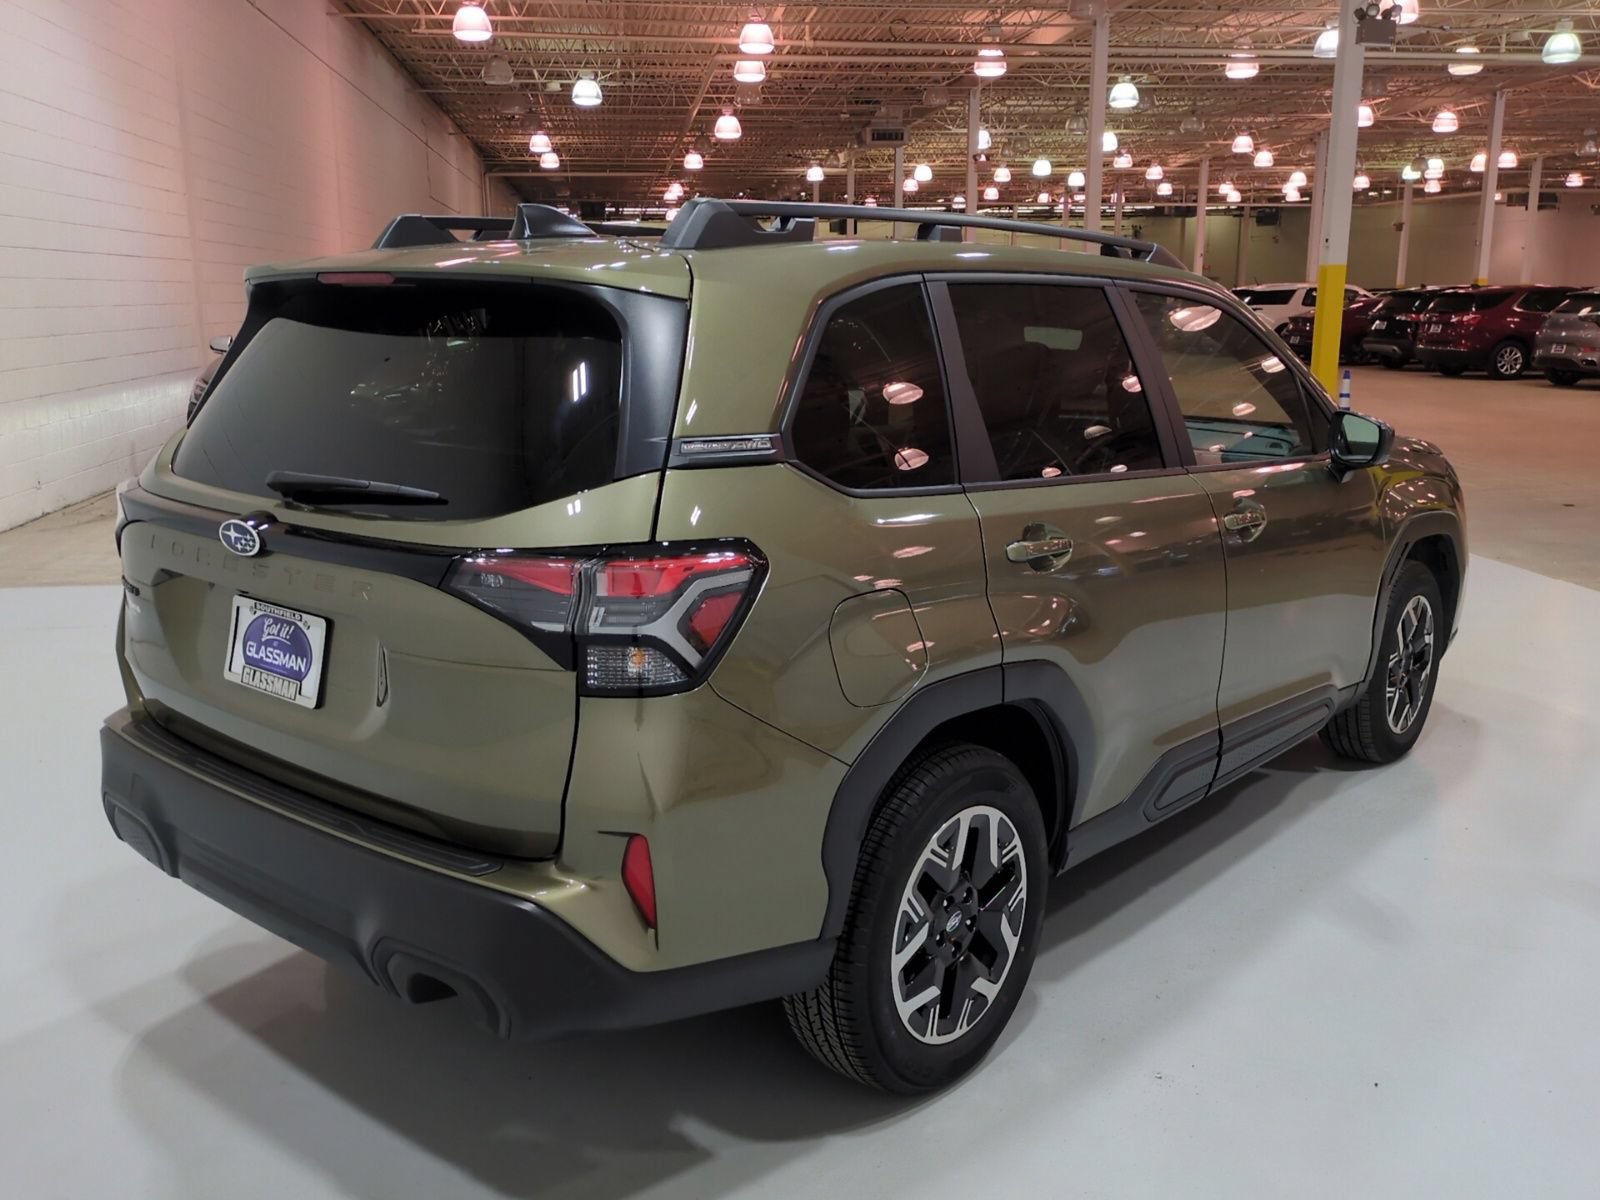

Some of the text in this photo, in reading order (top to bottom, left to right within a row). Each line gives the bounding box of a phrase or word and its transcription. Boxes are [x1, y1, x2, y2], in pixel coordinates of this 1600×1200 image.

[255, 603, 301, 620] SOUTHFIELD
[262, 617, 295, 640] Got it!
[246, 641, 307, 672] GLASSMAN
[243, 668, 297, 700] GLASSMAN
